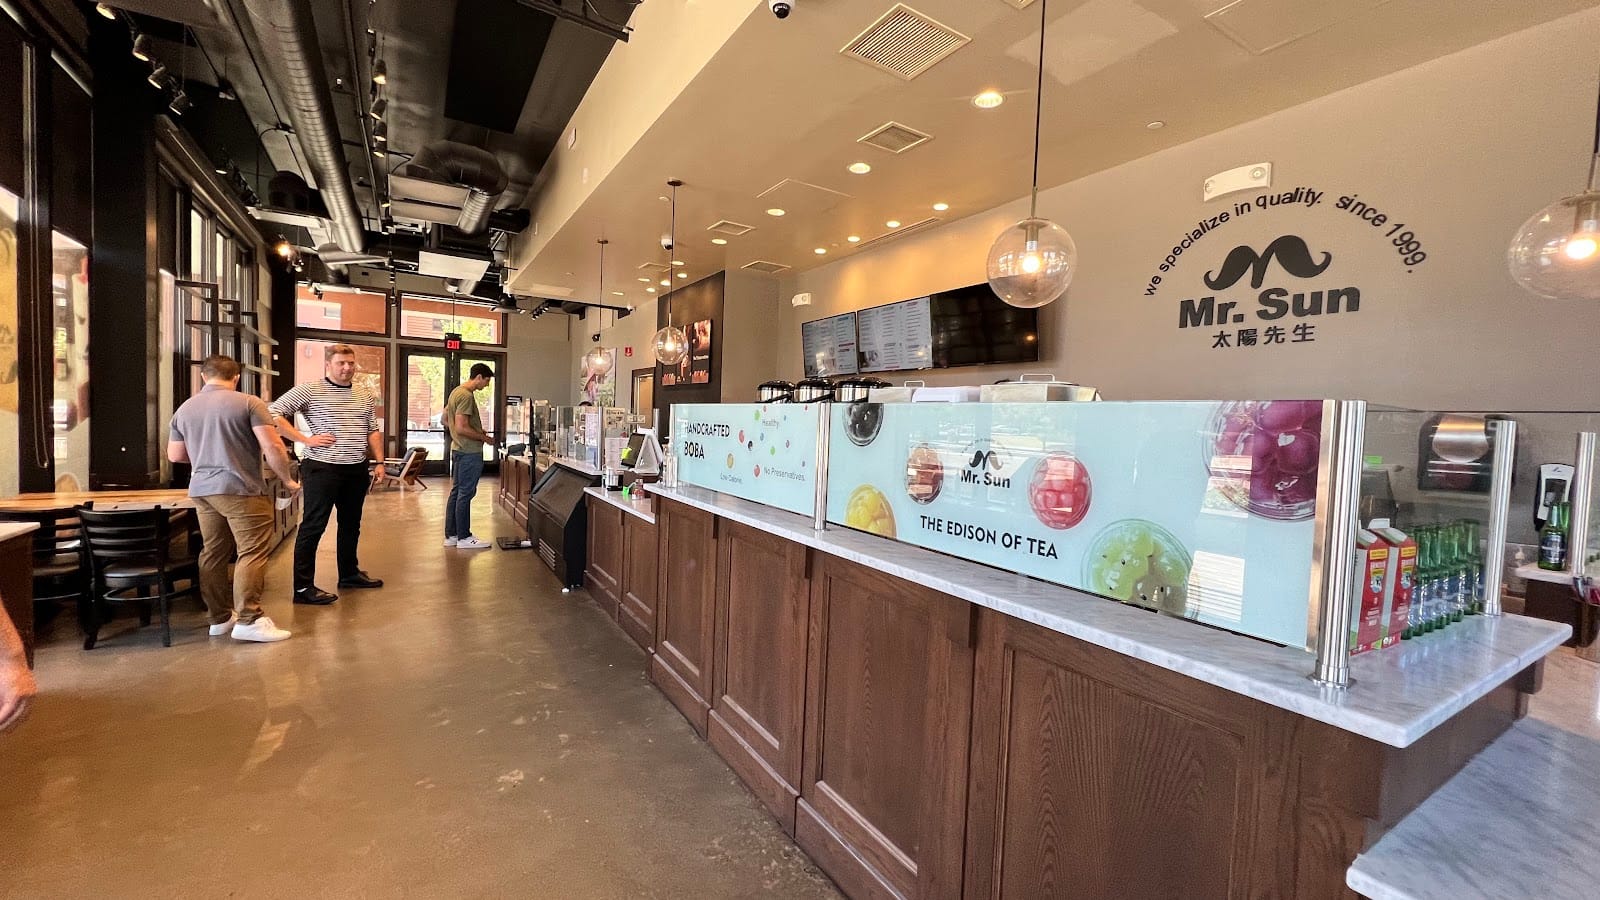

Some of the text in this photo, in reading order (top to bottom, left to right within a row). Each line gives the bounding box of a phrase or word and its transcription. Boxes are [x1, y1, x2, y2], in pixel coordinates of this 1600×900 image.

[1144, 187, 1427, 296] we specialize in quality. since 1999.
[1179, 286, 1361, 328] Mr. Sun
[1212, 323, 1316, 348] 太陽先生
[447, 340, 460, 350] EXIT
[684, 422, 730, 438] HANDCRAFTED
[762, 418, 779, 430] Healthy
[684, 441, 705, 460] BOBA
[764, 467, 771, 475] No
[961, 470, 1010, 488] Mr. Sun
[920, 515, 1058, 560] THE EDISON OF TEA
